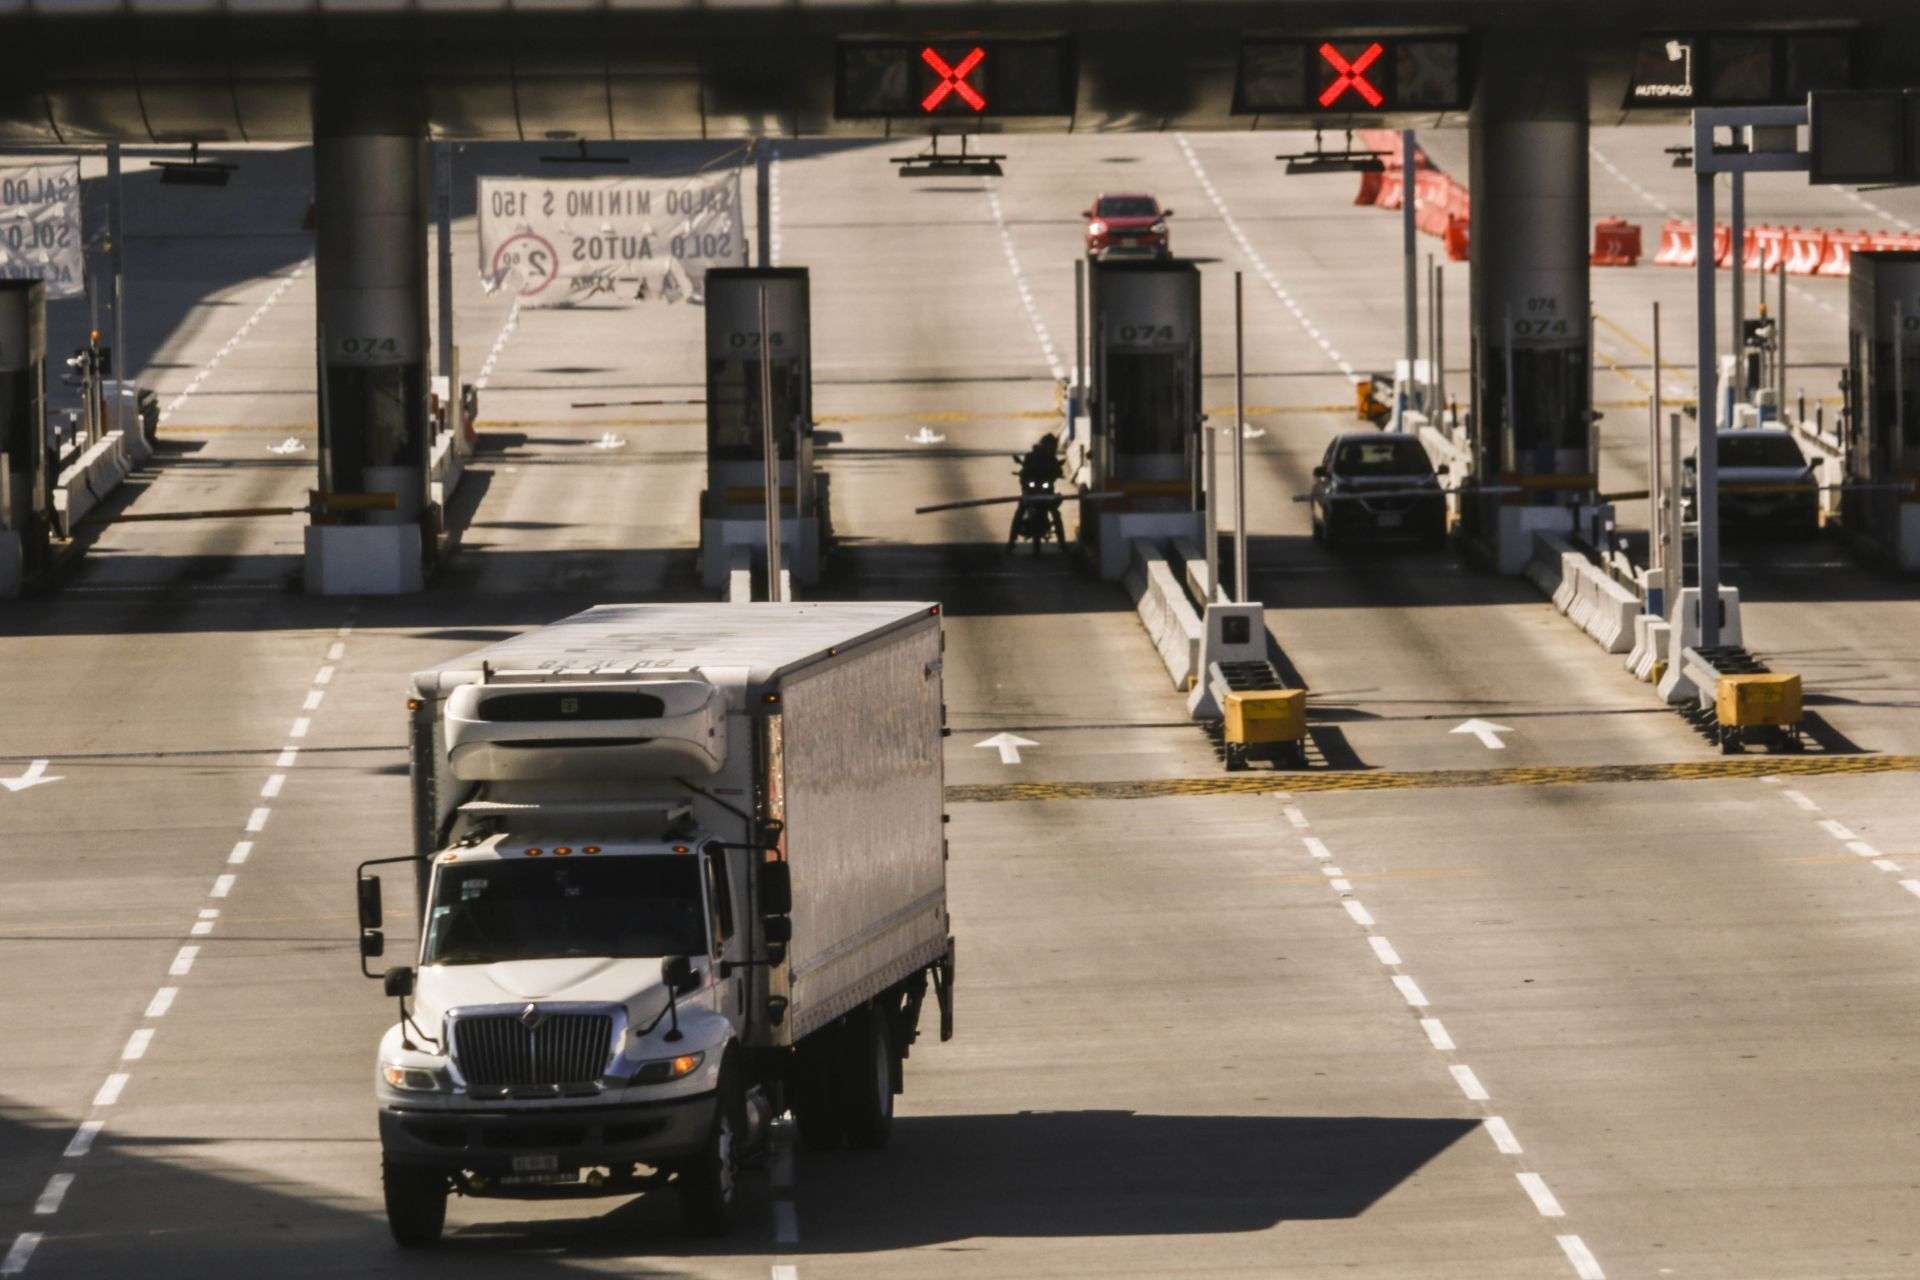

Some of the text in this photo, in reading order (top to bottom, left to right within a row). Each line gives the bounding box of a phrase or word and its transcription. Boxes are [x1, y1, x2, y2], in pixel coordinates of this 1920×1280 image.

[1634, 84, 1693, 97] AUTOPAGO
[1120, 324, 1174, 341] 074
[1514, 319, 1568, 336] 074
[343, 337, 396, 354] 074
